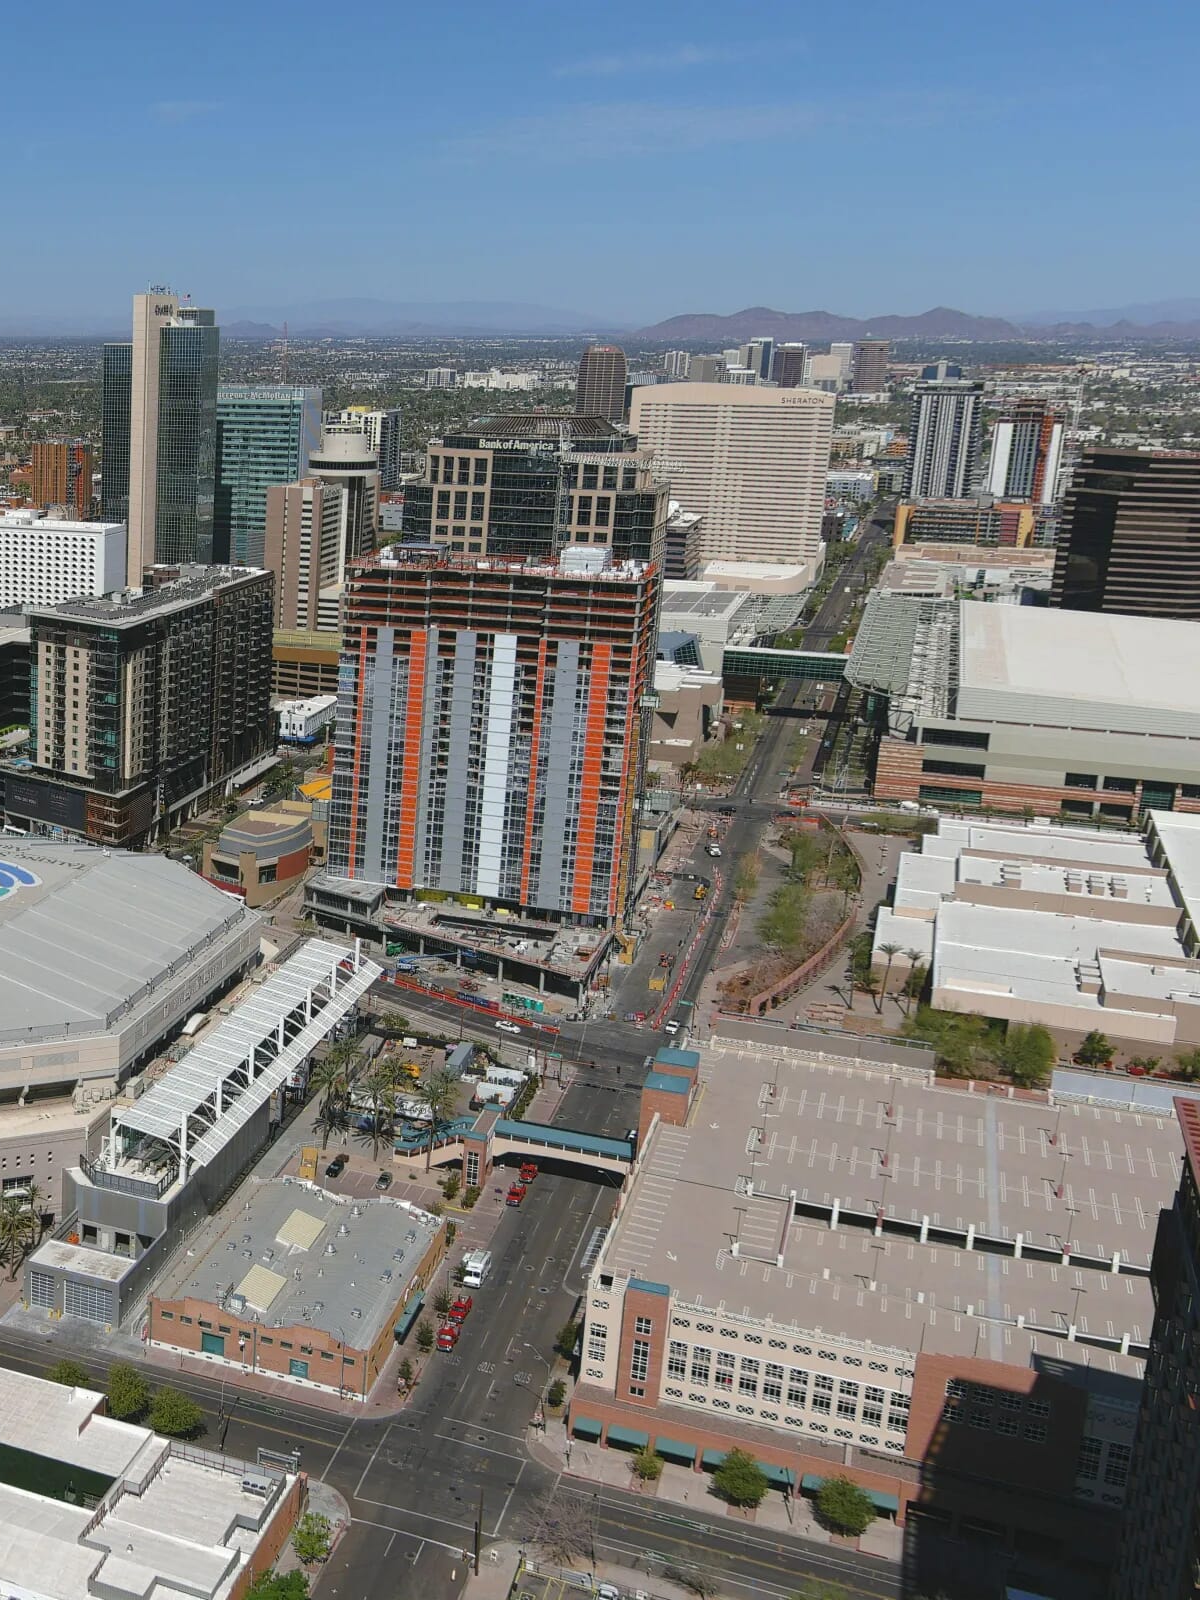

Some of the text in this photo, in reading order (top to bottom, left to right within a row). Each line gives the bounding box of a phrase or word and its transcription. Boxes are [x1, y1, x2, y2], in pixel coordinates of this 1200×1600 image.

[781, 397, 825, 405] SHERATON
[479, 438, 554, 451] Bank of America
[476, 1361, 496, 1374] STOP
[513, 1371, 533, 1384] STOP
